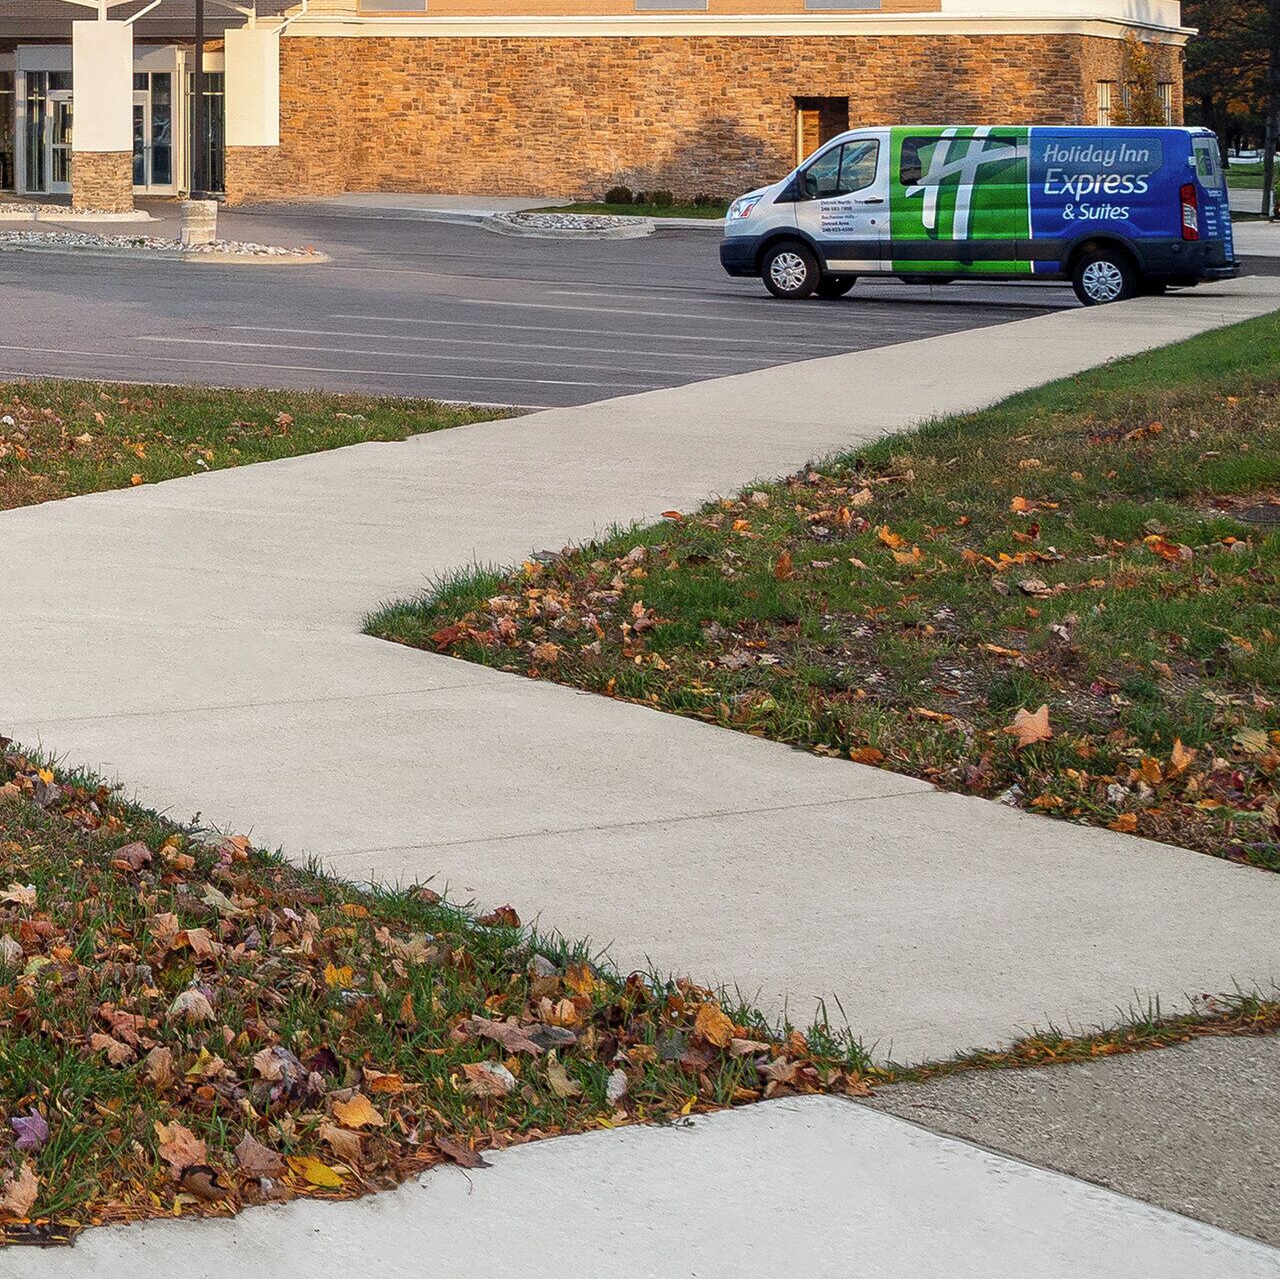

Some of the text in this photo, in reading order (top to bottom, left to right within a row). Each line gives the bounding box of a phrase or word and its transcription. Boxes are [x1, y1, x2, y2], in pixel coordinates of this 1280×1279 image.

[1042, 143, 1150, 167] Holiday Inn
[1043, 168, 1150, 201] Express
[1062, 203, 1130, 220] & Suites
